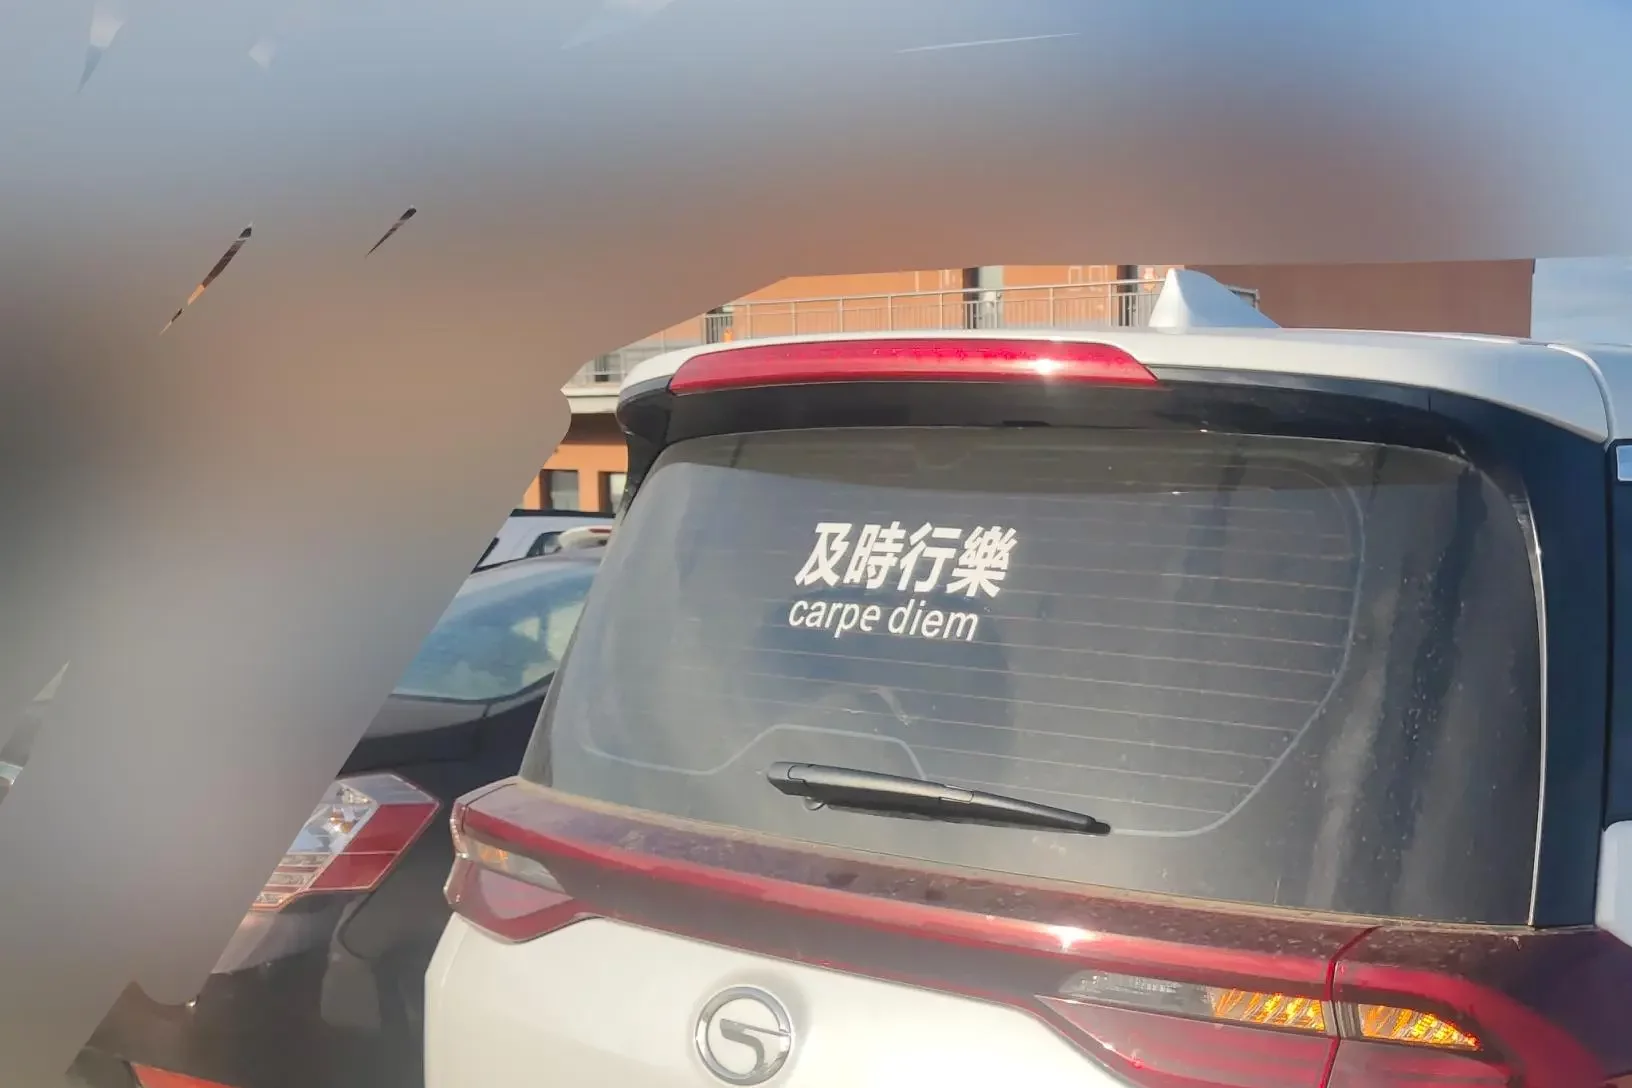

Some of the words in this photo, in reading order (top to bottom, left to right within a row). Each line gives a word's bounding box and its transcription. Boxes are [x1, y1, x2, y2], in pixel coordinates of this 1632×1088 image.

[795, 521, 1018, 597] 及時行樂
[788, 599, 880, 638] carpe
[887, 598, 979, 642] diem
